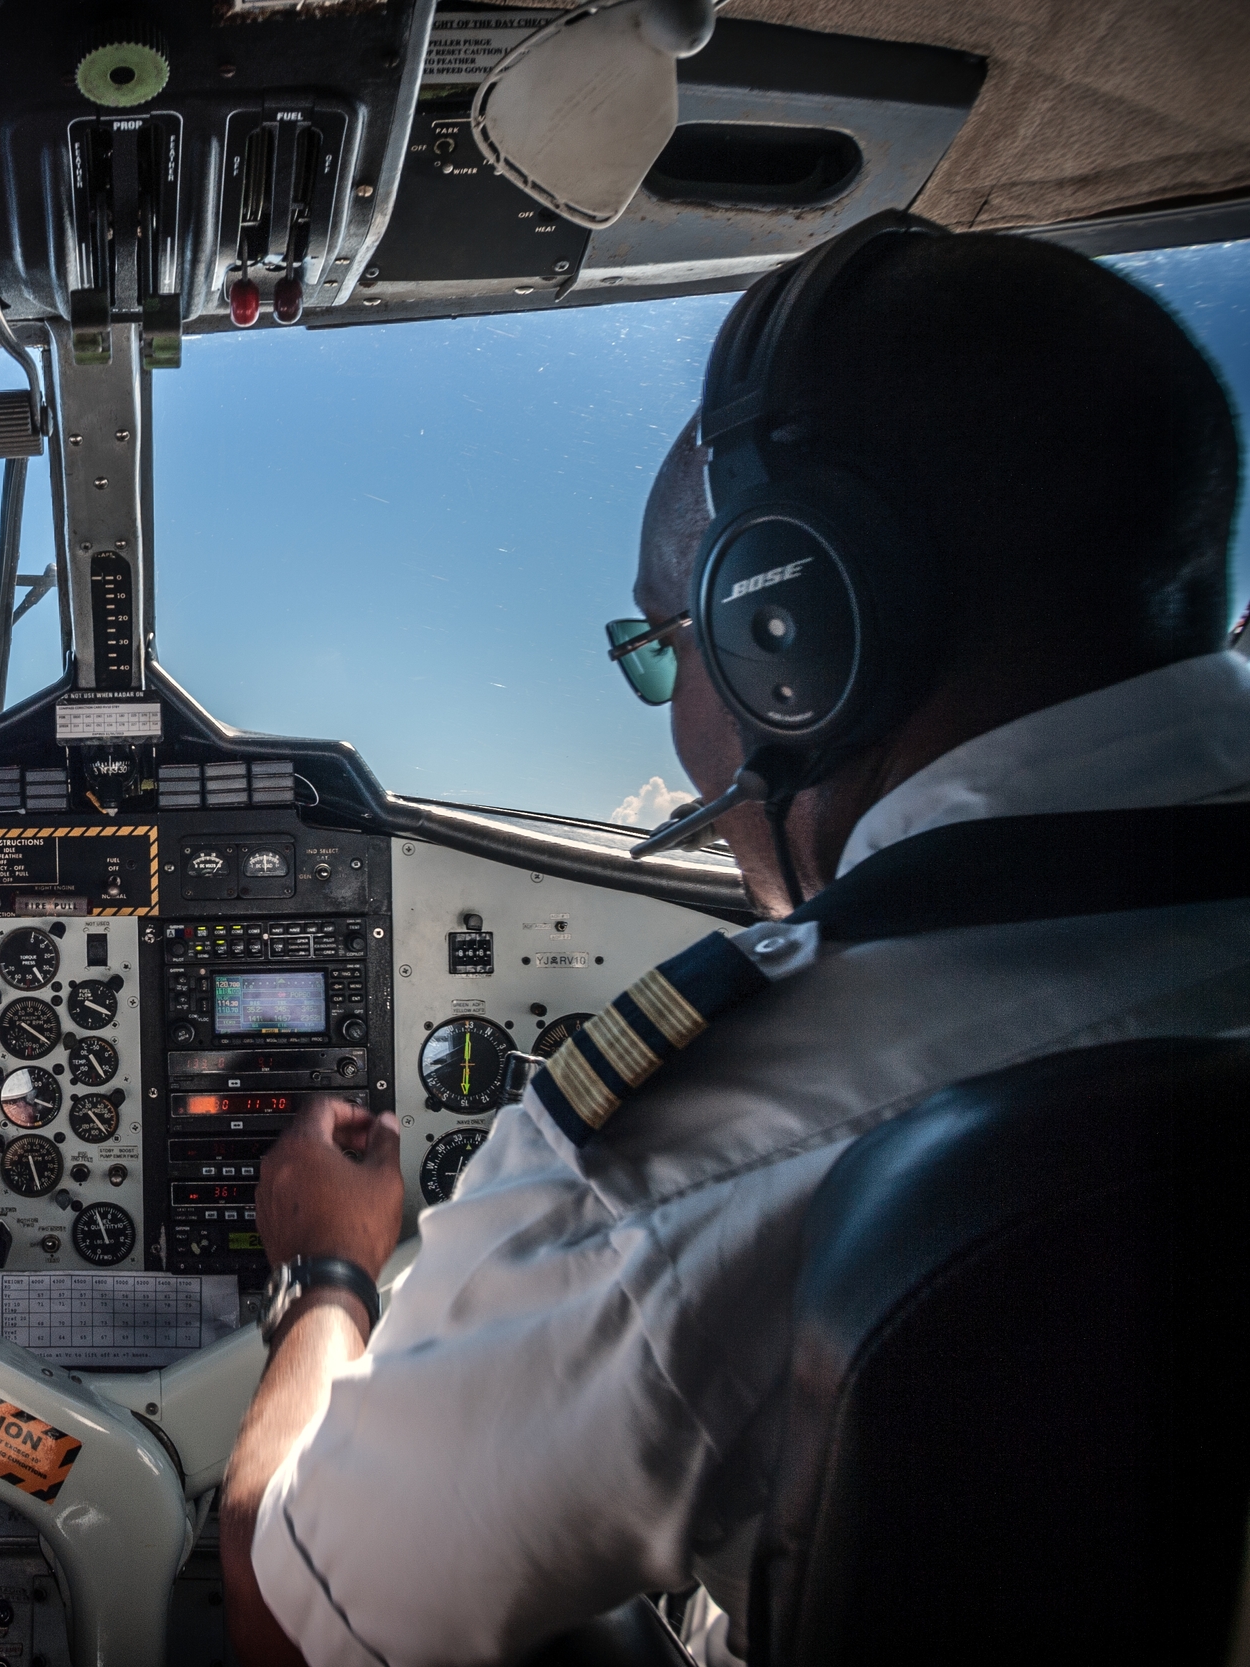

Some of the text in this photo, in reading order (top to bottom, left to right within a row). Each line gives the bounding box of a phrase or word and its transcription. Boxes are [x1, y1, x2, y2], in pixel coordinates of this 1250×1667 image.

[457, 19, 469, 28] OF
[471, 19, 492, 28] THE
[495, 18, 516, 28] DAY
[463, 39, 492, 47] PURGE
[435, 48, 462, 56] RESET
[464, 47, 502, 55] CAUTION
[436, 57, 476, 65] FEATHER
[437, 66, 463, 74] SPEED
[276, 111, 304, 121] FUEL
[113, 120, 143, 132] PROP
[435, 127, 460, 135] PARK
[453, 167, 478, 175] WIPER
[517, 211, 534, 219] OFF
[722, 556, 815, 604] BOSE
[117, 614, 129, 622] 20
[24, 902, 78, 910] FIRE PULL
[436, 1143, 446, 1153] 30
[3, 1440, 30, 1459] EXCEED
[6, 1455, 48, 1480] CONDITIONS
